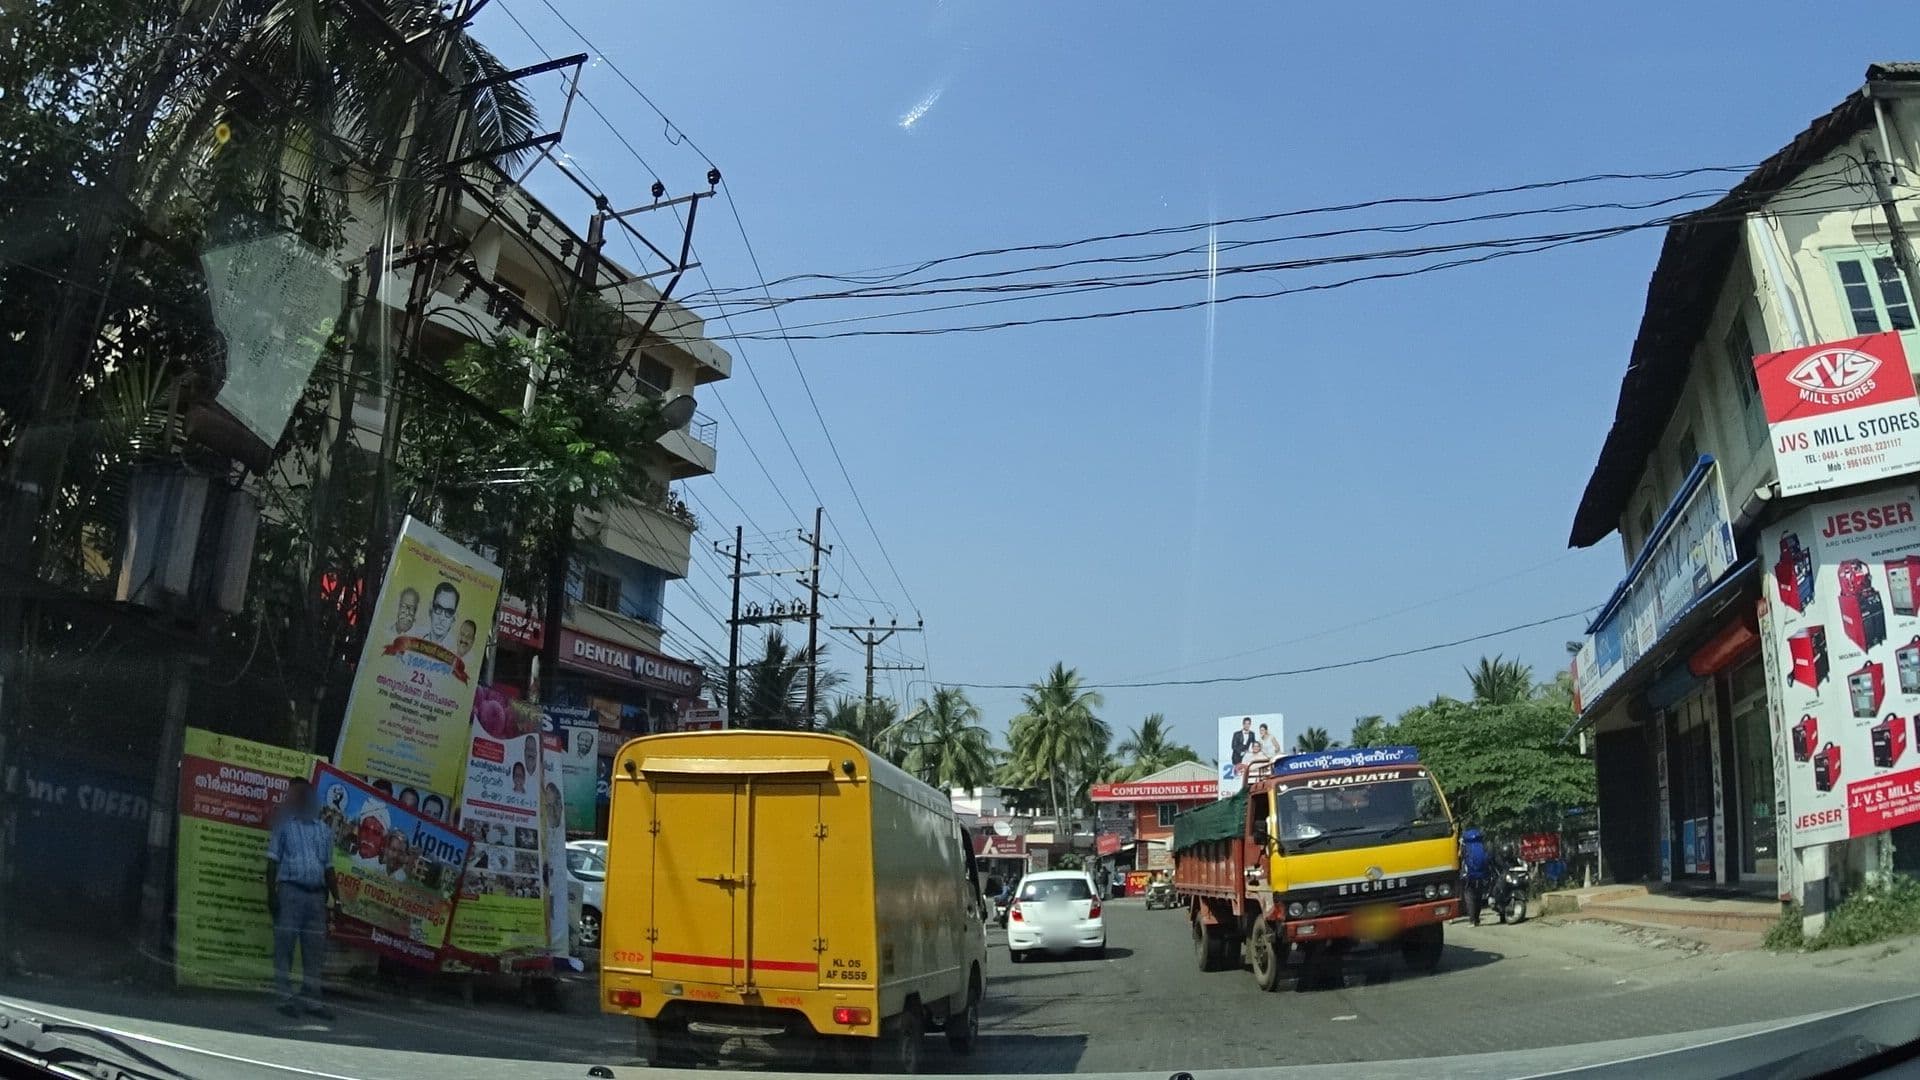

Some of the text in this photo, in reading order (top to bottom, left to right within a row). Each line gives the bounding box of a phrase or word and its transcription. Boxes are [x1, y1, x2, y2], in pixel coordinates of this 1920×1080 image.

[1794, 353, 1874, 387] JVS
[1799, 378, 1877, 405] MILL STORES
[1778, 411, 1920, 454] JVS MILL STORES
[1822, 448, 1839, 461] 0484
[1822, 502, 1914, 538] JESSER
[574, 639, 692, 688] DENTAL CLINIC
[1307, 771, 1400, 788] PYNADATH
[1111, 785, 1188, 796] COMPUTRONIKS
[1888, 784, 1912, 799] MILL
[1795, 809, 1842, 830] JESSER
[1339, 878, 1408, 896] EICHER
[832, 959, 846, 968] KL
[826, 970, 839, 980] AF
